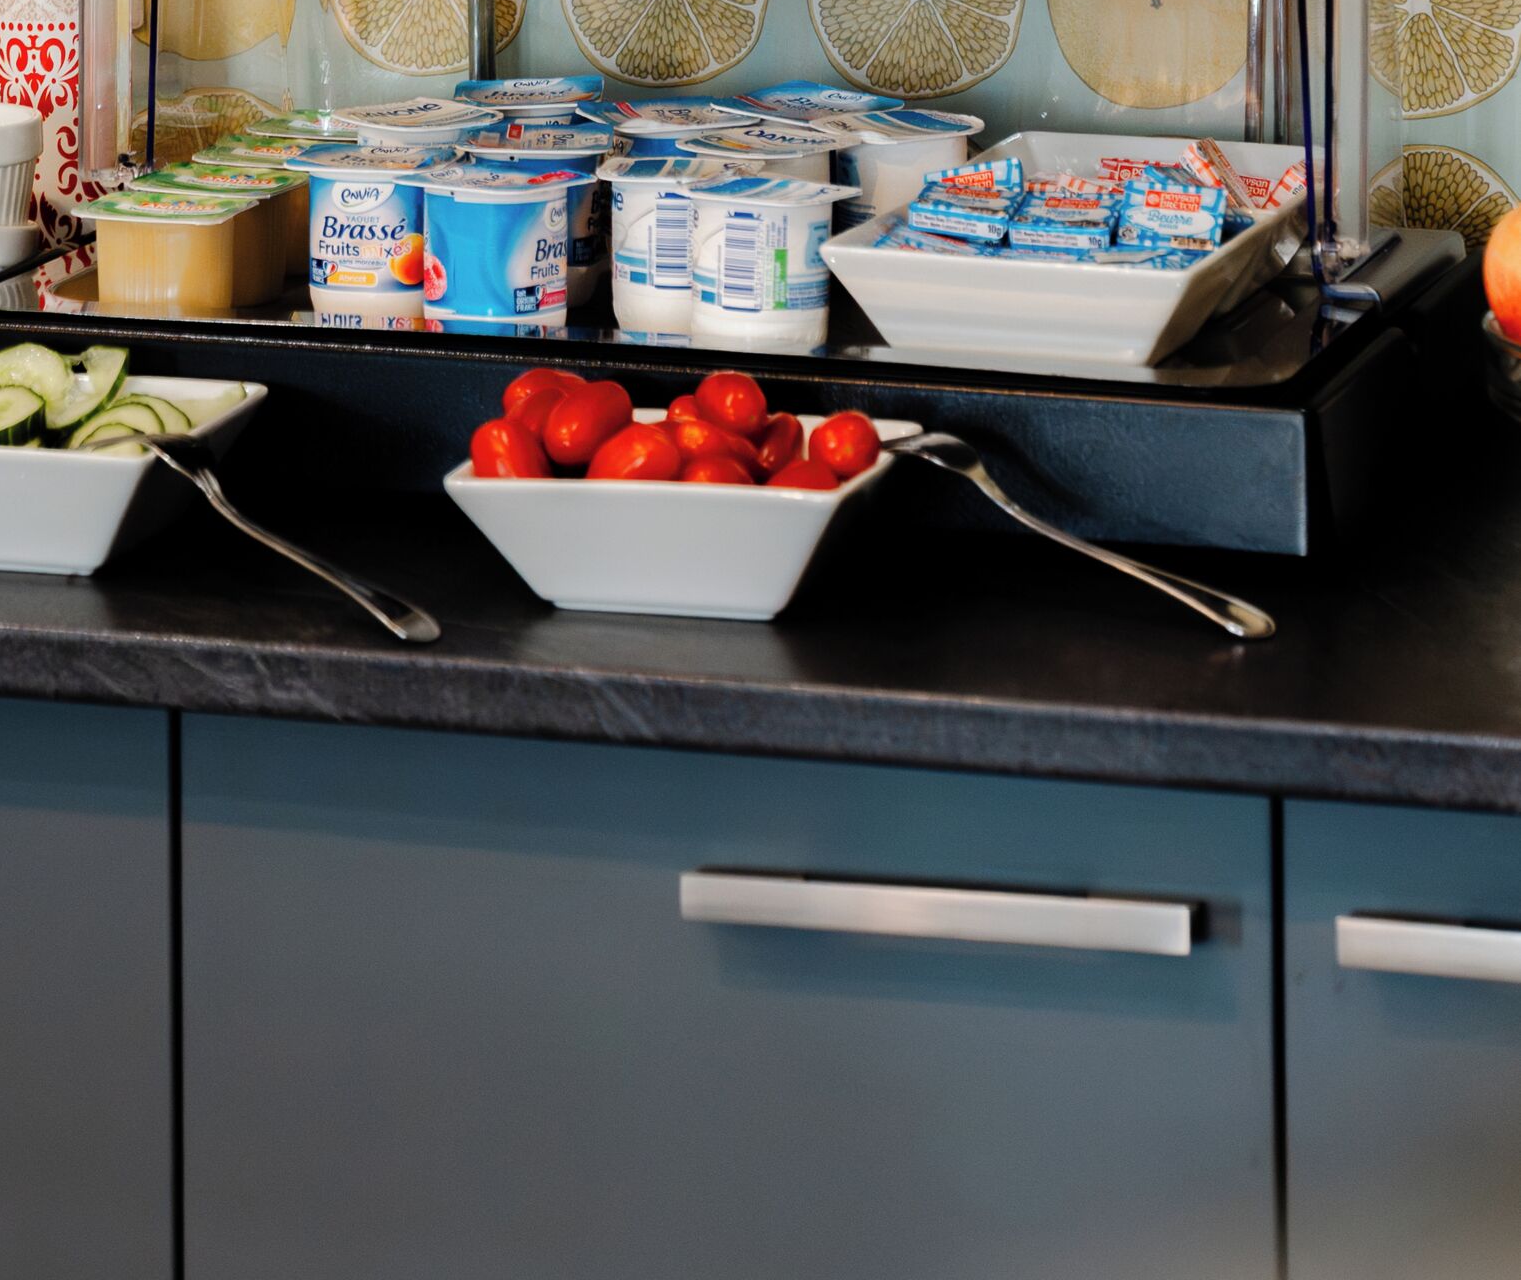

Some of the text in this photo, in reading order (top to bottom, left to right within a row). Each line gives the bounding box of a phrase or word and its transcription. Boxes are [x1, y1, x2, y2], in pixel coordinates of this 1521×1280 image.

[322, 216, 406, 241] Brassé
[987, 224, 1002, 237] 10g
[319, 240, 360, 256] Fruits
[1089, 236, 1102, 248] 10g
[530, 263, 560, 280] Fruits
